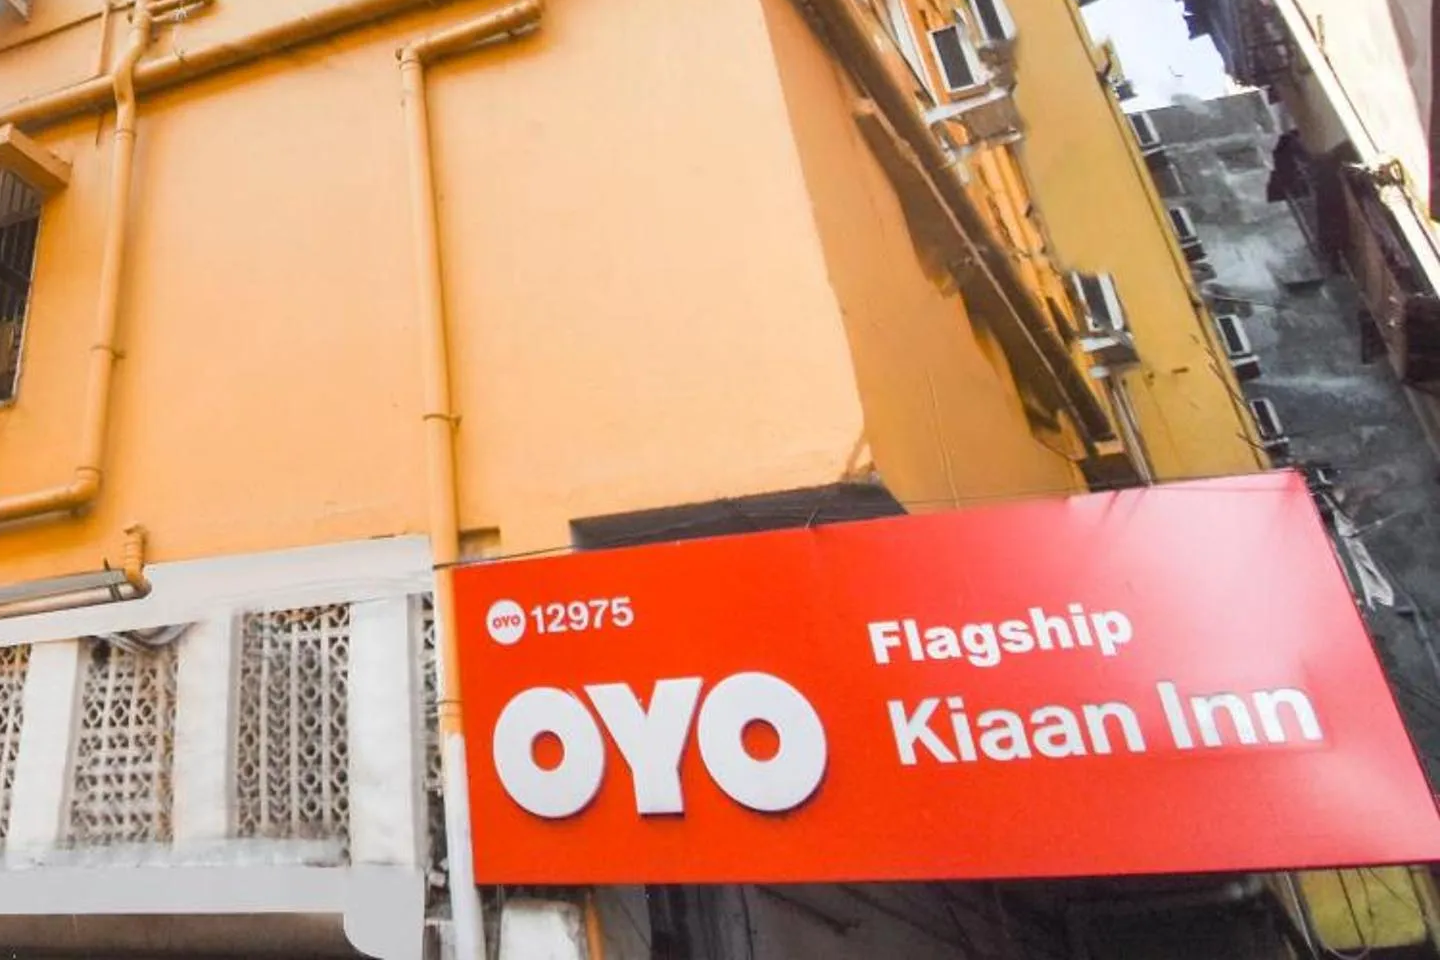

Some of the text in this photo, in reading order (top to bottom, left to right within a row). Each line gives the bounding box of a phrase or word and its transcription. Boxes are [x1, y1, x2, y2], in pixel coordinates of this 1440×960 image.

[492, 597, 634, 634] OYO 12975
[867, 603, 1133, 667] Flagship
[492, 671, 828, 819] OYO
[887, 681, 1324, 765] Kiaan Inn
